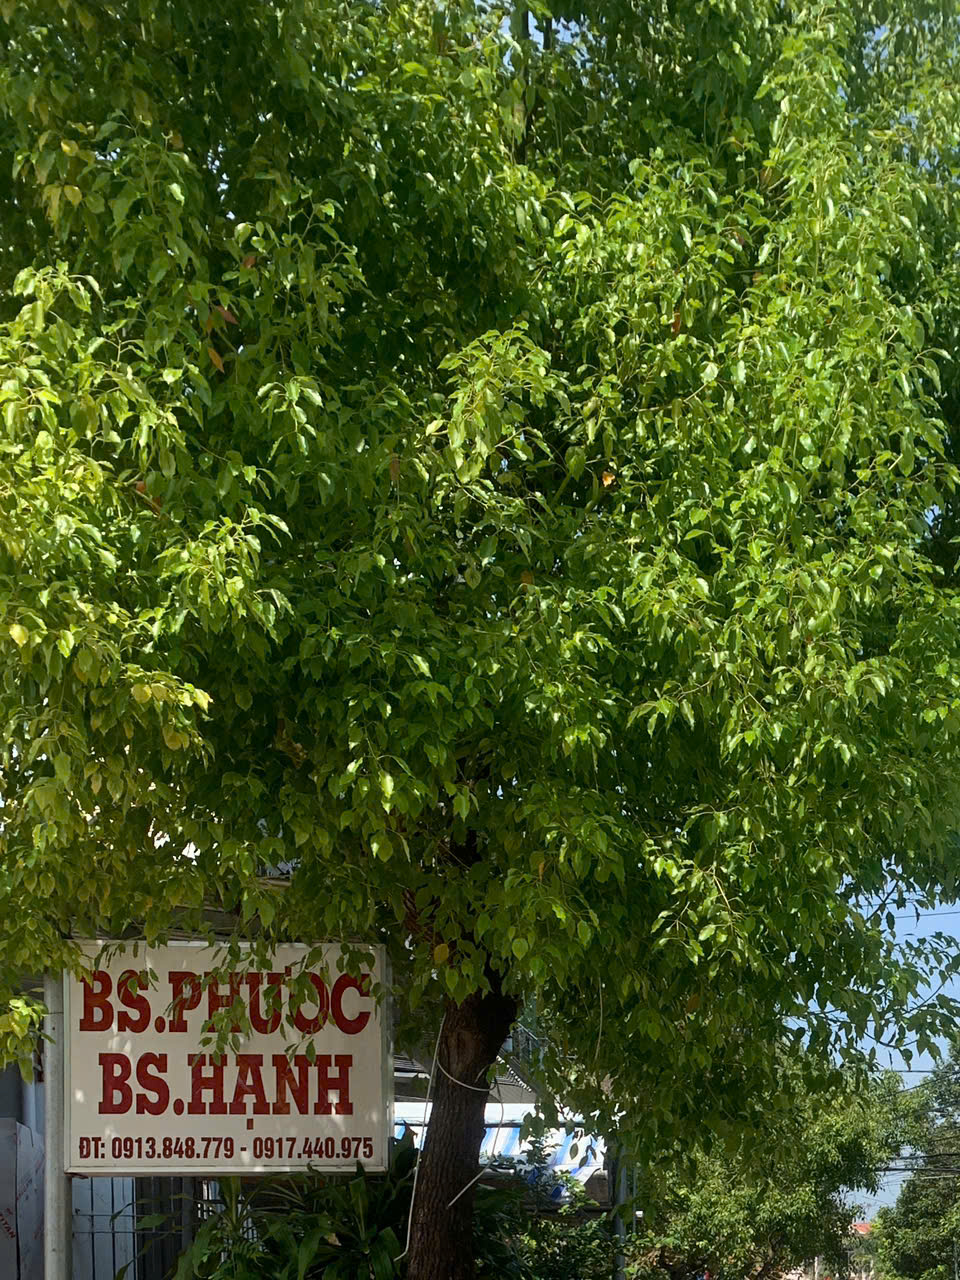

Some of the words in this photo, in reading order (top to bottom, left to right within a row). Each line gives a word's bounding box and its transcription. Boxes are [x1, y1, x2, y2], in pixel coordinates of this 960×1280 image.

[79, 1136, 105, 1159] ĐT:
[111, 1136, 235, 1159] 0913.848.779
[253, 1136, 374, 1159] 0917.440.975
